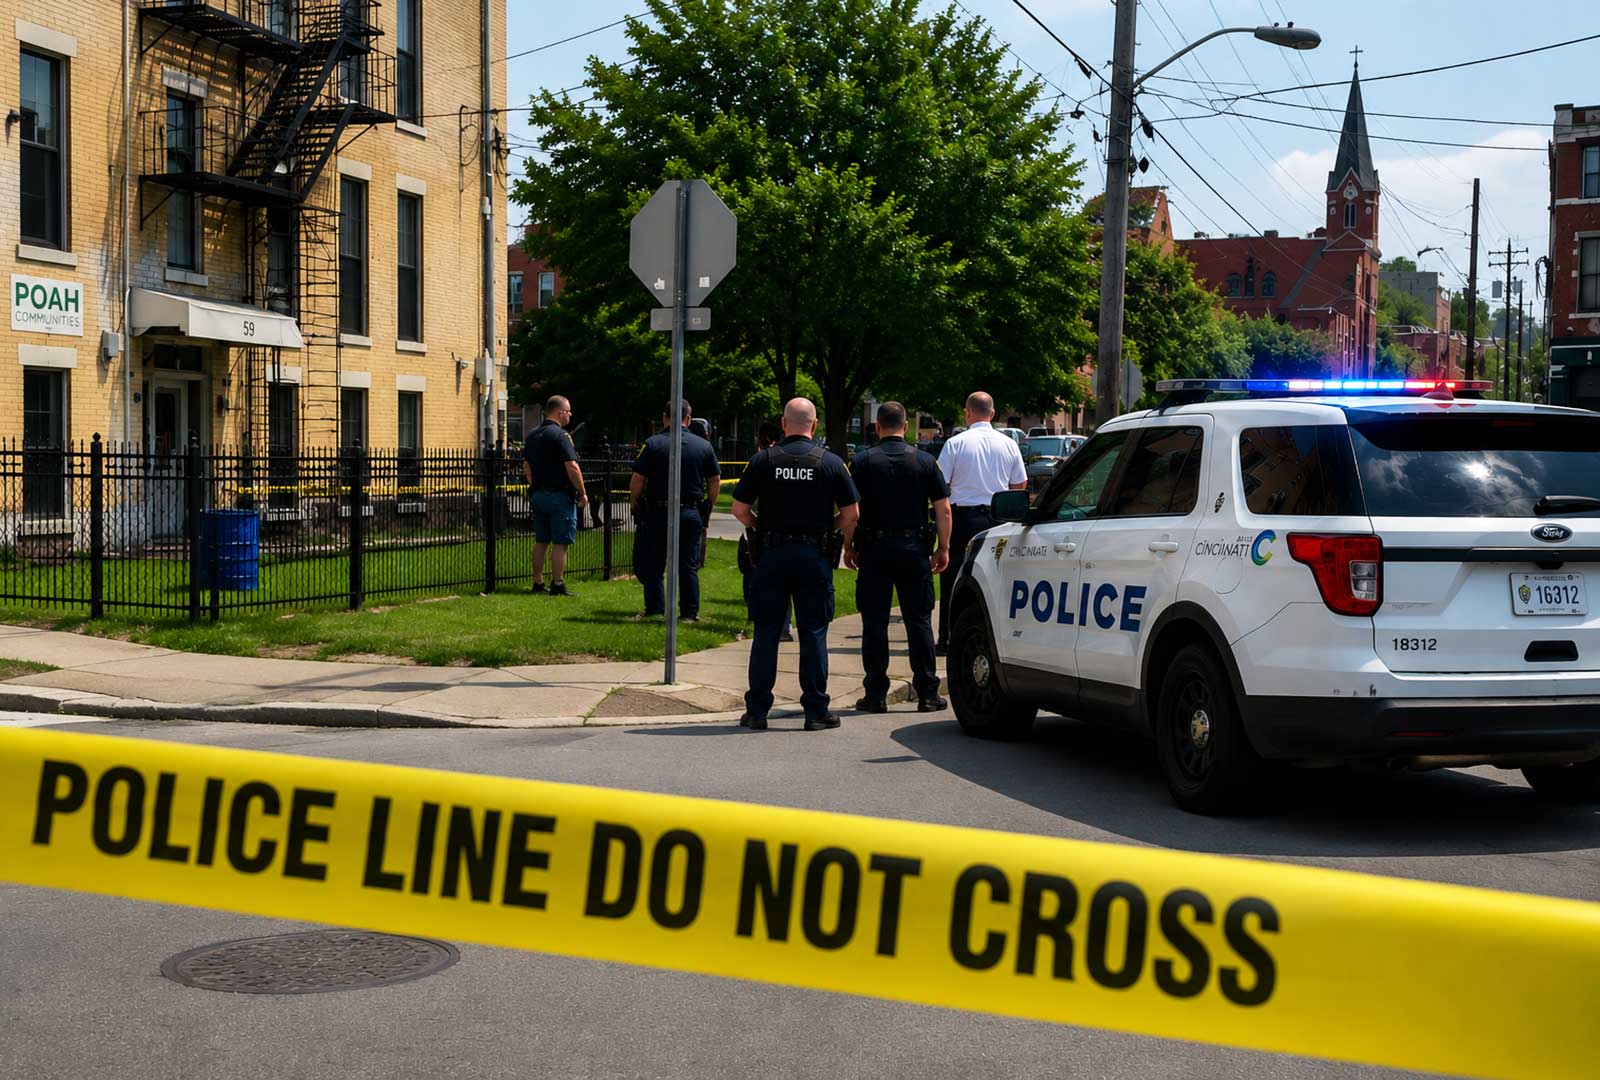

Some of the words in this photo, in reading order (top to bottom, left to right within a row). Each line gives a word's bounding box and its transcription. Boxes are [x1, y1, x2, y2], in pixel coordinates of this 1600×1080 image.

[15, 282, 79, 313] POAH
[15, 310, 81, 328] COMMUNITIES
[243, 320, 255, 337] 59
[775, 467, 814, 481] POLICE
[1536, 585, 1579, 604] 16312
[1009, 580, 1147, 632] POLICE
[1392, 637, 1437, 651] 18312
[32, 759, 337, 883] POLICE
[362, 796, 557, 911] LINE
[584, 821, 707, 930] DO
[736, 839, 922, 957] NOT
[949, 865, 1281, 1008] CROSS
